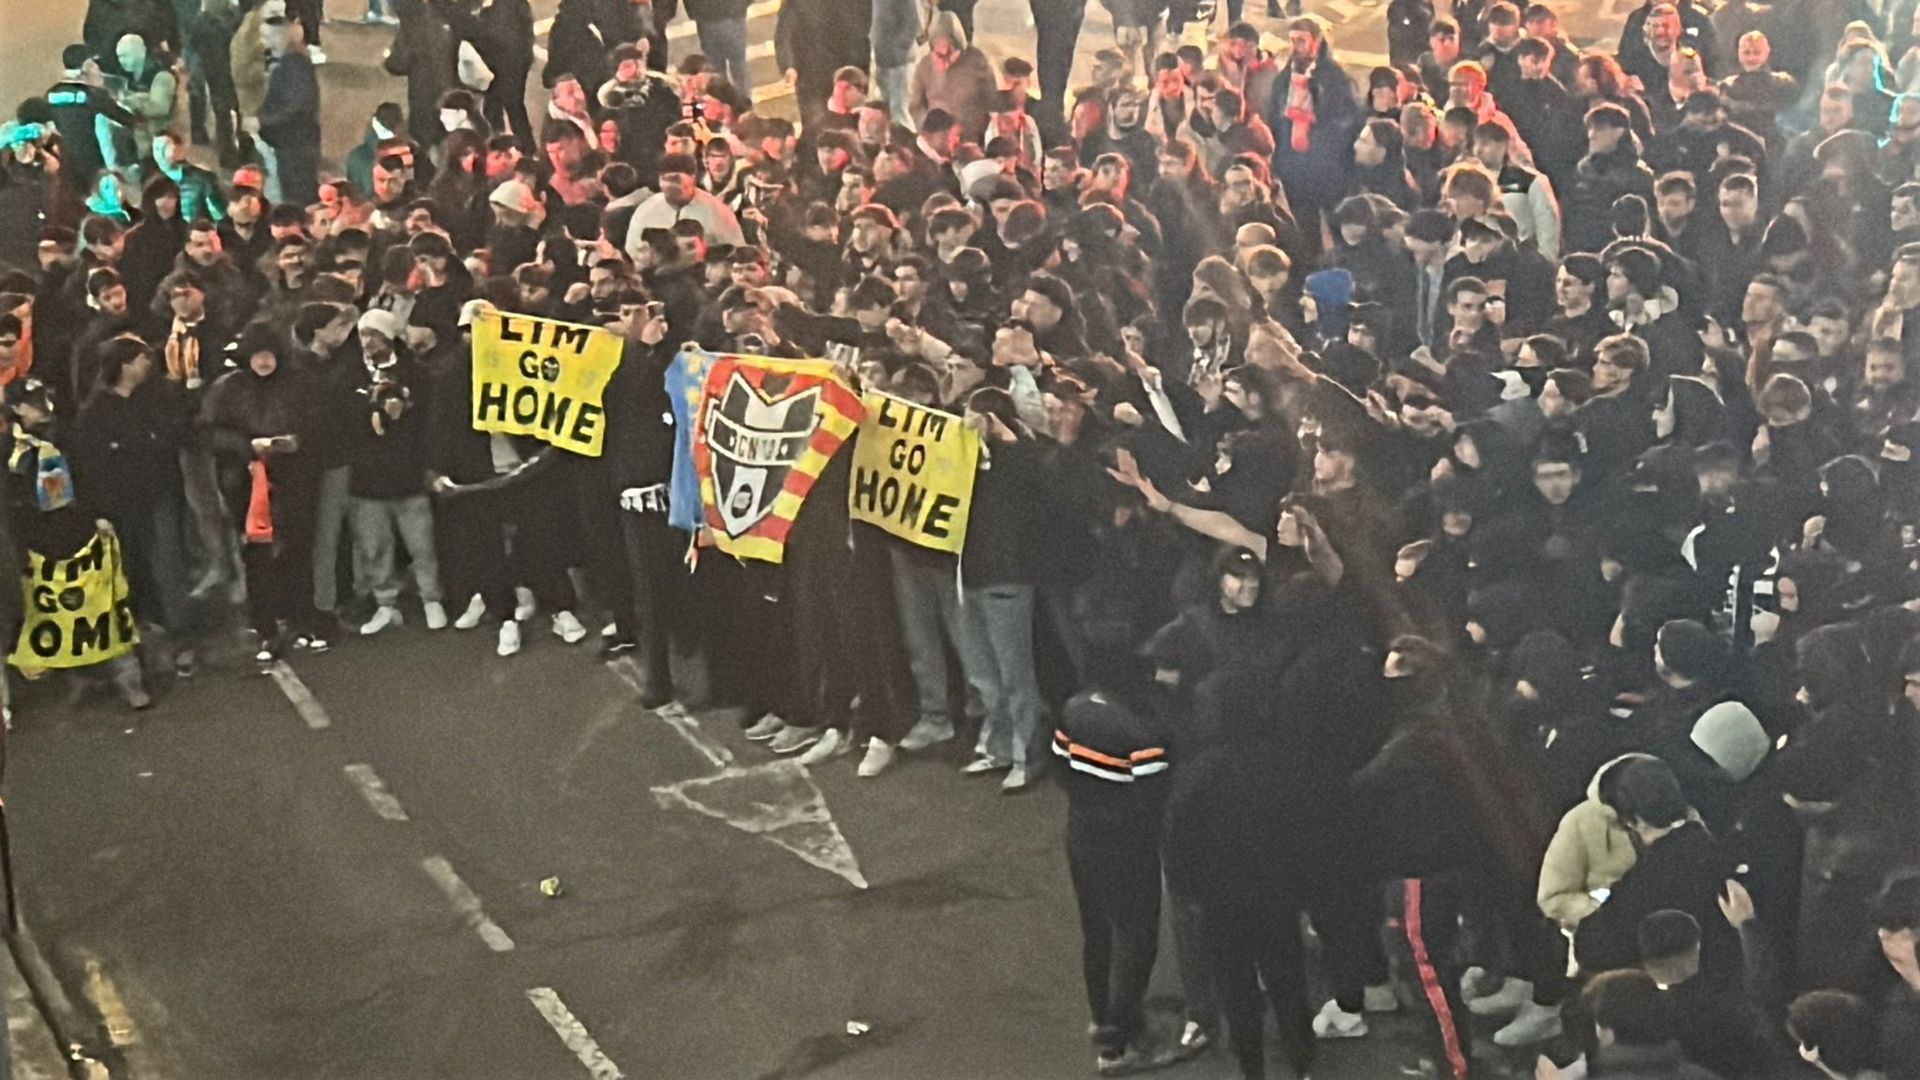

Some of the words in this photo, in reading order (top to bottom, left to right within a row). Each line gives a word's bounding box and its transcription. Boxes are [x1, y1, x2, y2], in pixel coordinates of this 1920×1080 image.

[519, 350, 560, 382] GO
[478, 382, 602, 443] HOME
[890, 439, 926, 475] GO
[854, 466, 960, 538] HOME
